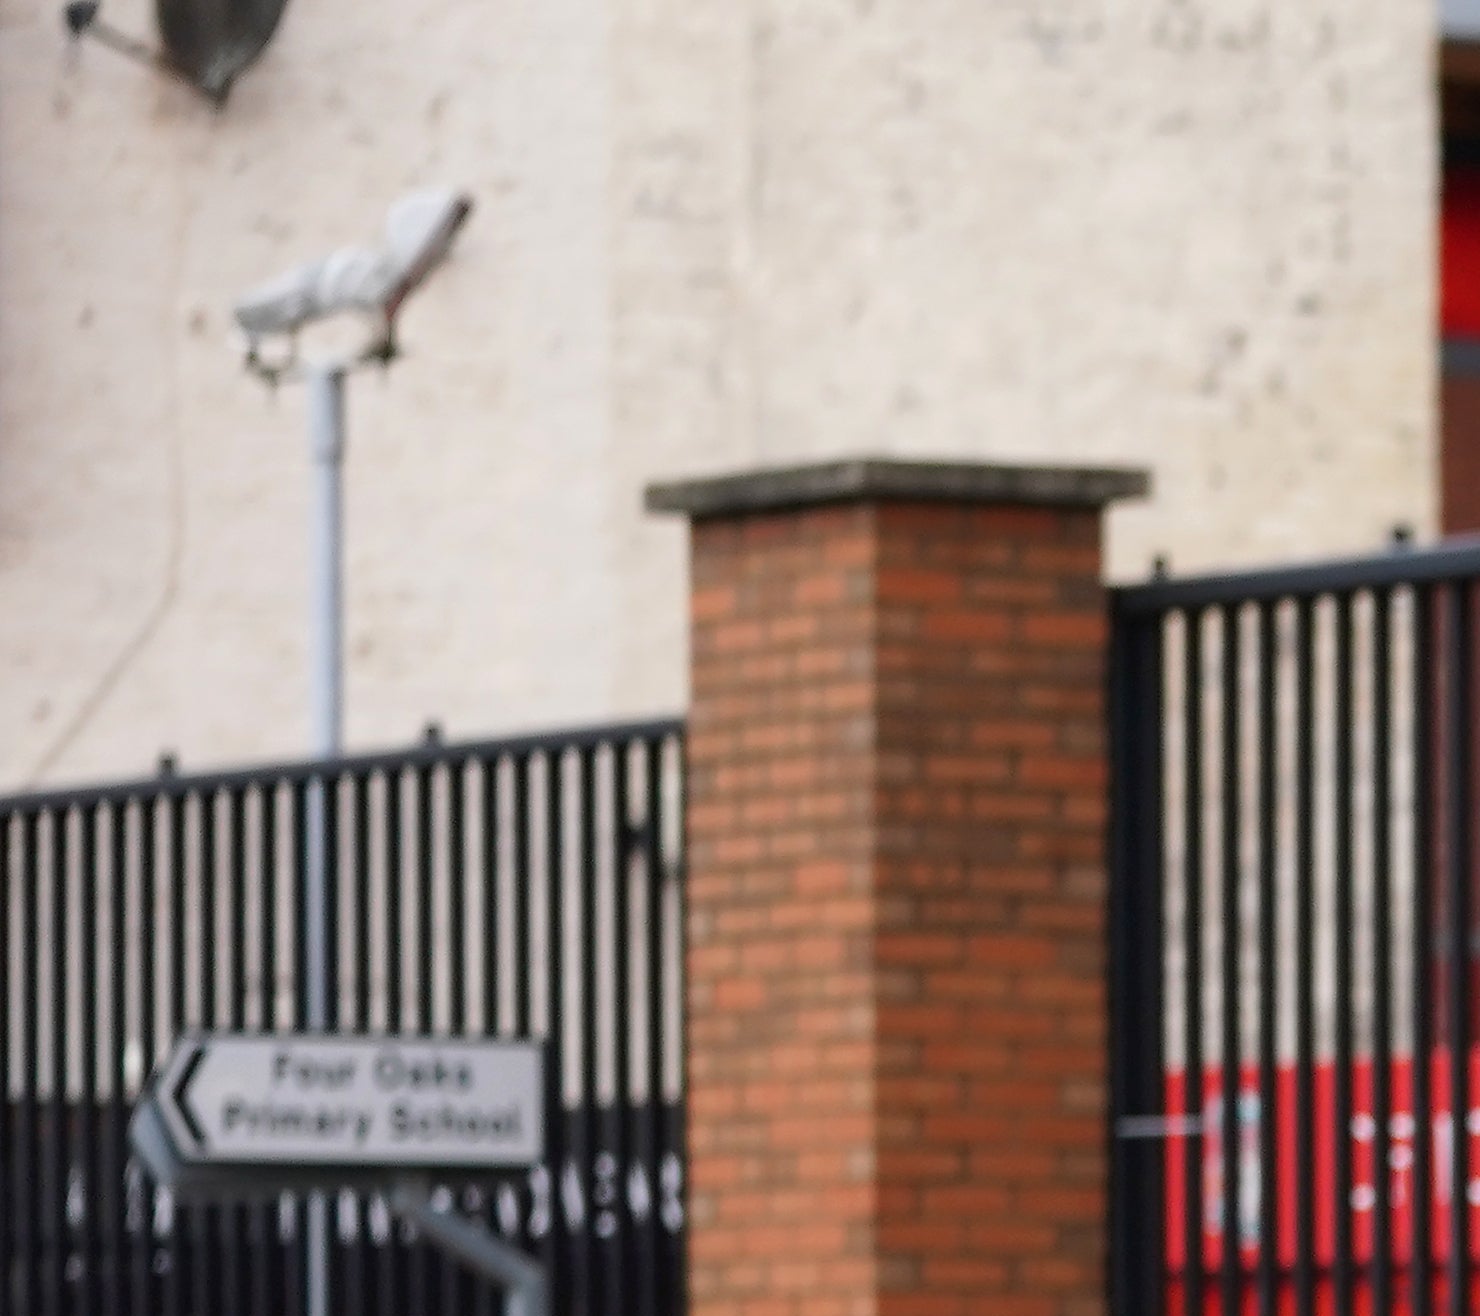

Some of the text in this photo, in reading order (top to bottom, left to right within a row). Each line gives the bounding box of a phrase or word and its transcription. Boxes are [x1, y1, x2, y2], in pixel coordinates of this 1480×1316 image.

[272, 1052, 471, 1089] Four Oaks
[223, 1099, 520, 1147] Primary School
